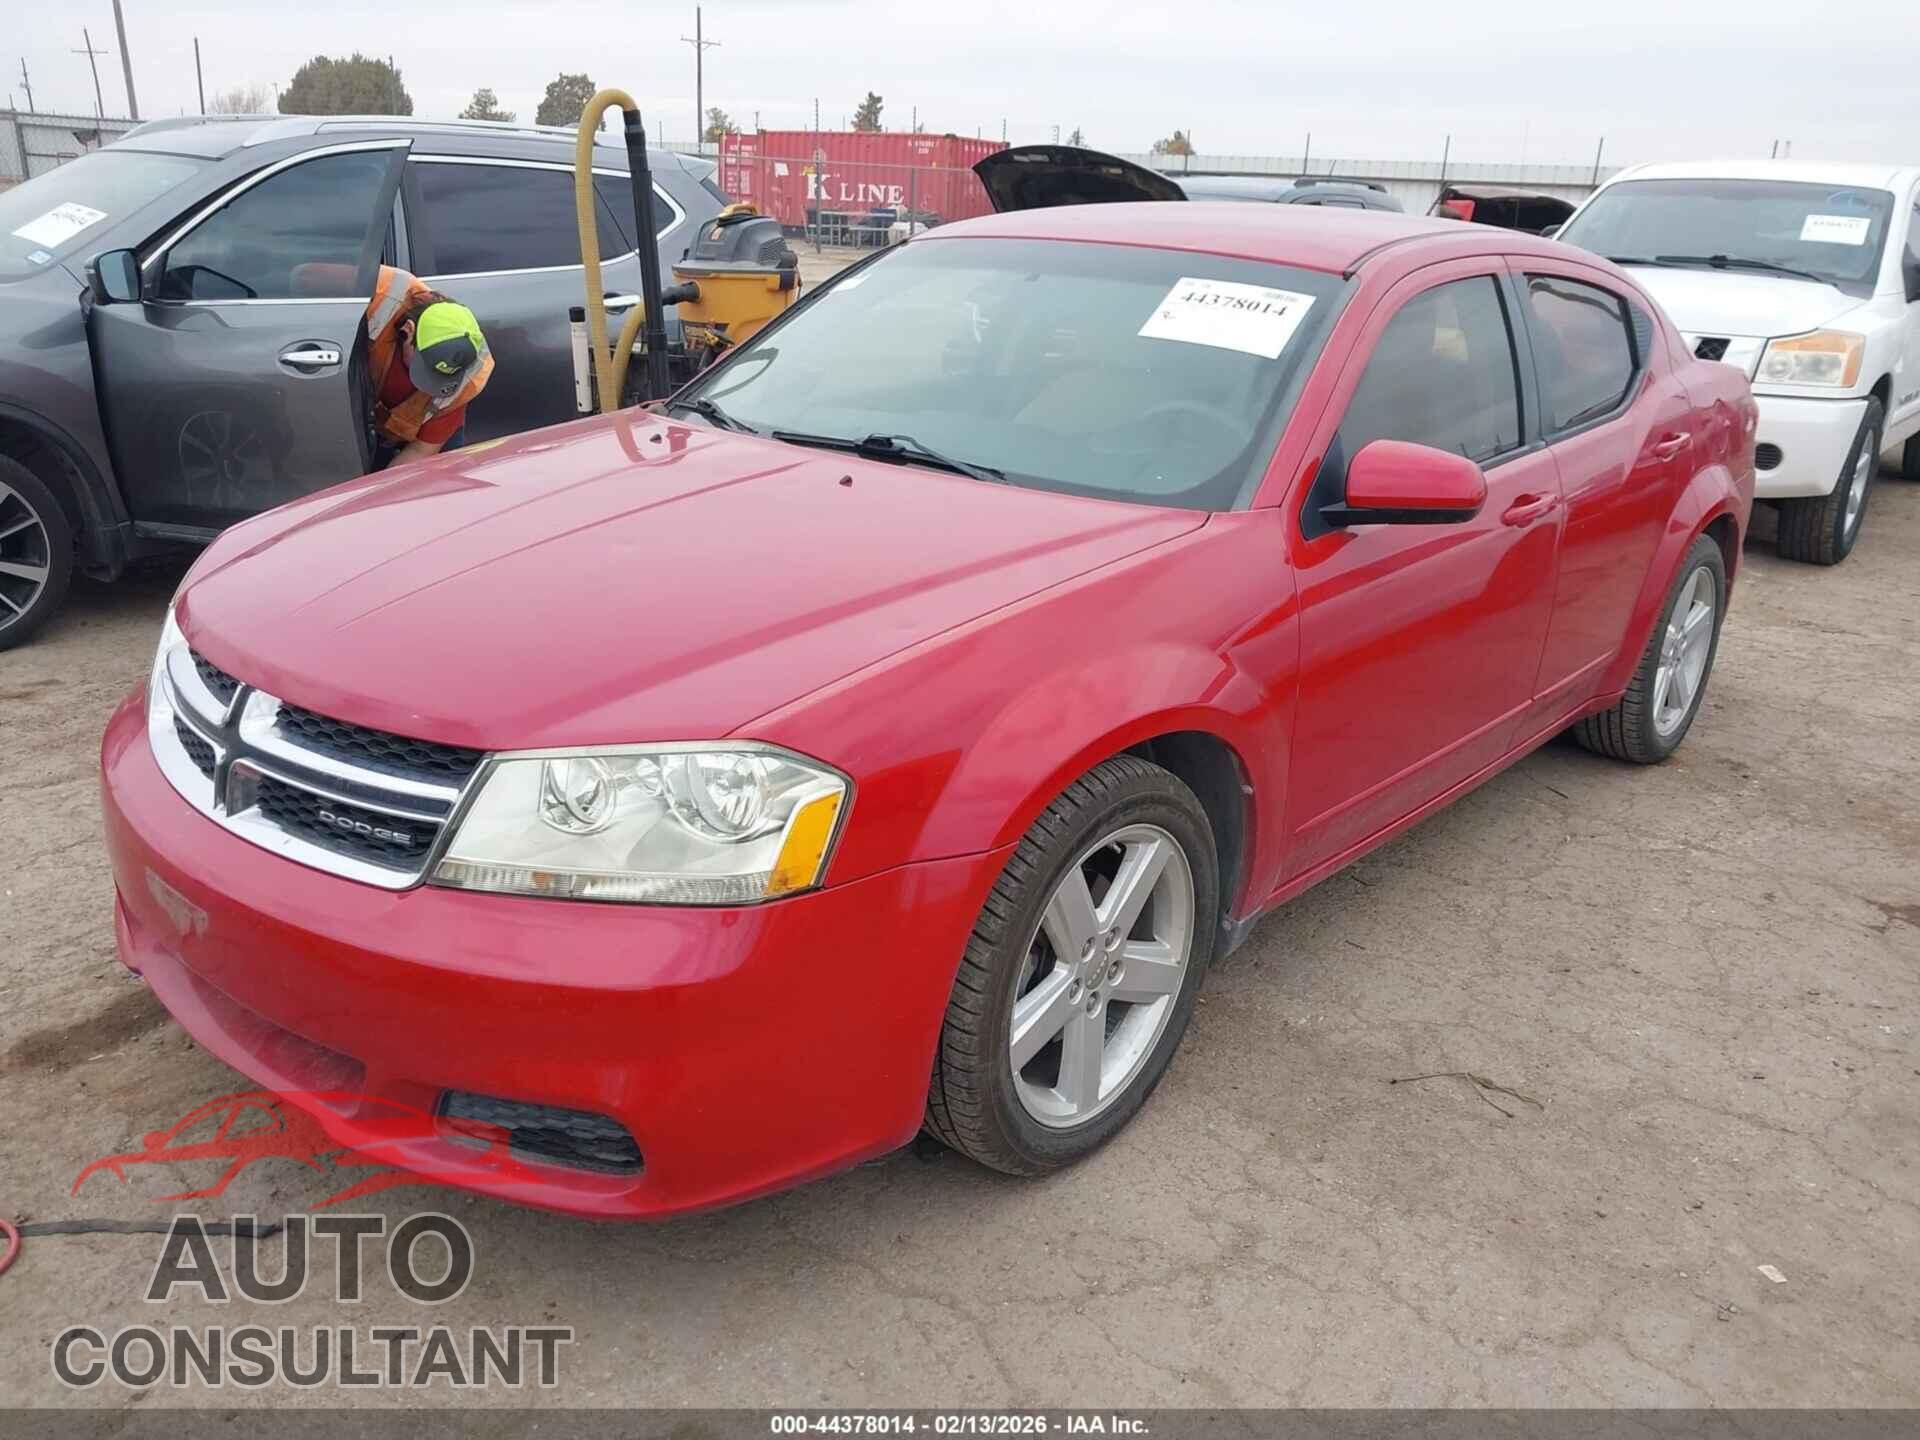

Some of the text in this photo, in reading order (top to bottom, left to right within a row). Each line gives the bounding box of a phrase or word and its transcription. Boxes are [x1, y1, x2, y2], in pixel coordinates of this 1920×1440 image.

[807, 173, 904, 203] K LINE
[1181, 291, 1288, 317] 44378014
[319, 810, 412, 845] DODGE
